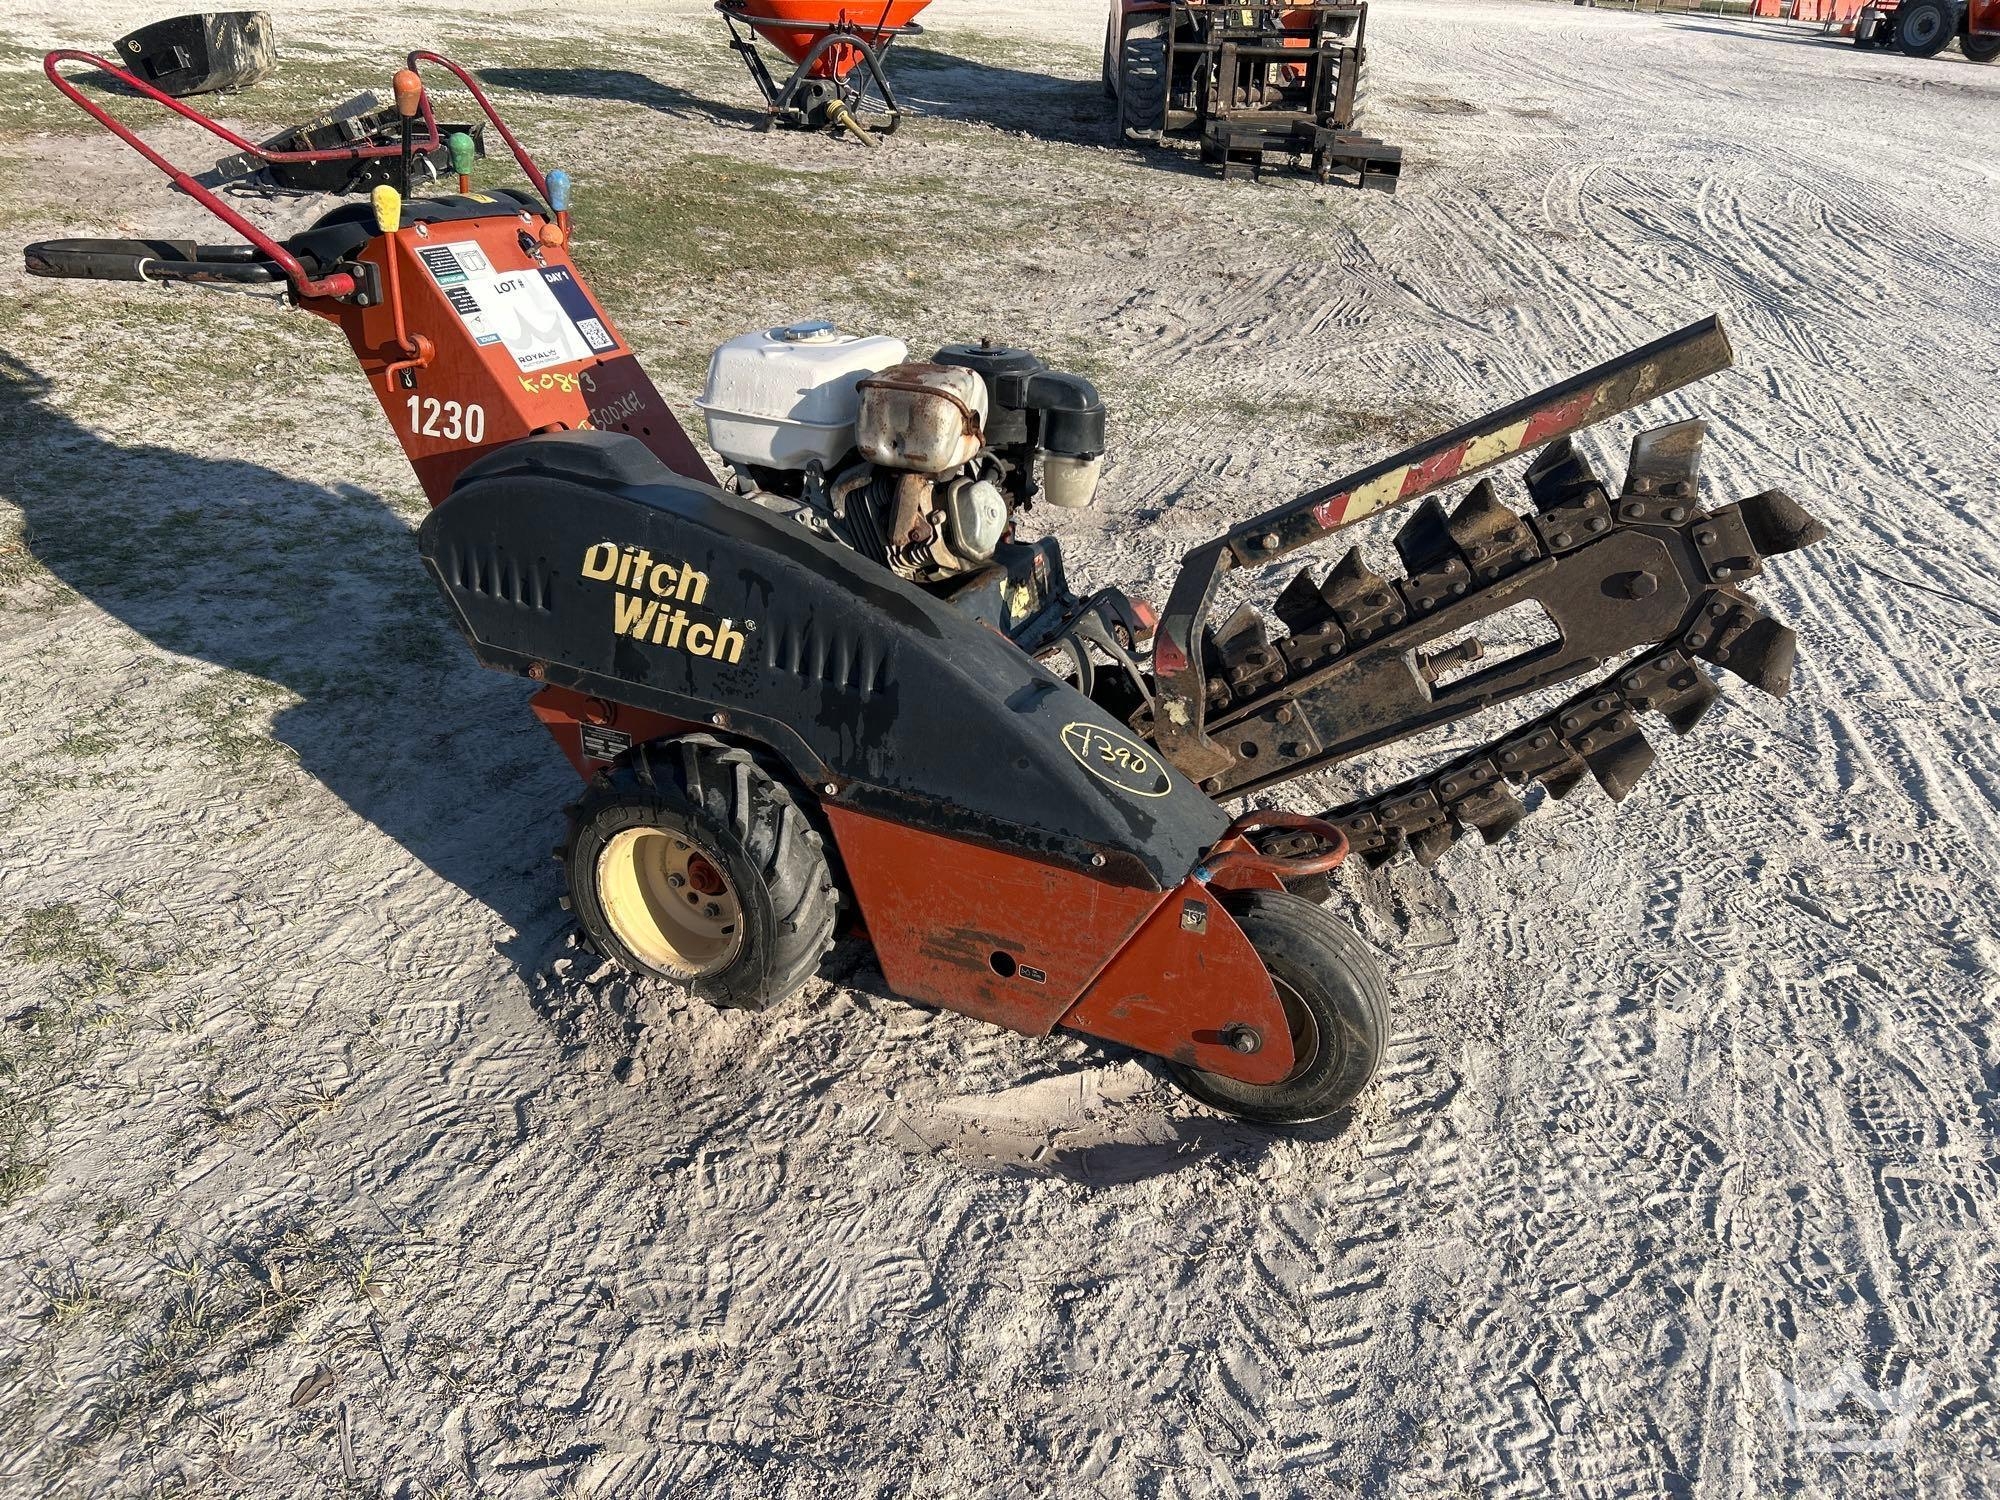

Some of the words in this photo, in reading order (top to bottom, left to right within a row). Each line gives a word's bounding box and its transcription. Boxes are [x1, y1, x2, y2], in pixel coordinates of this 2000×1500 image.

[494, 280, 517, 294] LOT
[544, 272, 563, 283] DAY
[562, 271, 569, 280] 1
[518, 351, 550, 363] ROYAL
[407, 395, 485, 443] 1230
[581, 542, 709, 605] Ditch
[614, 591, 746, 664] Witch
